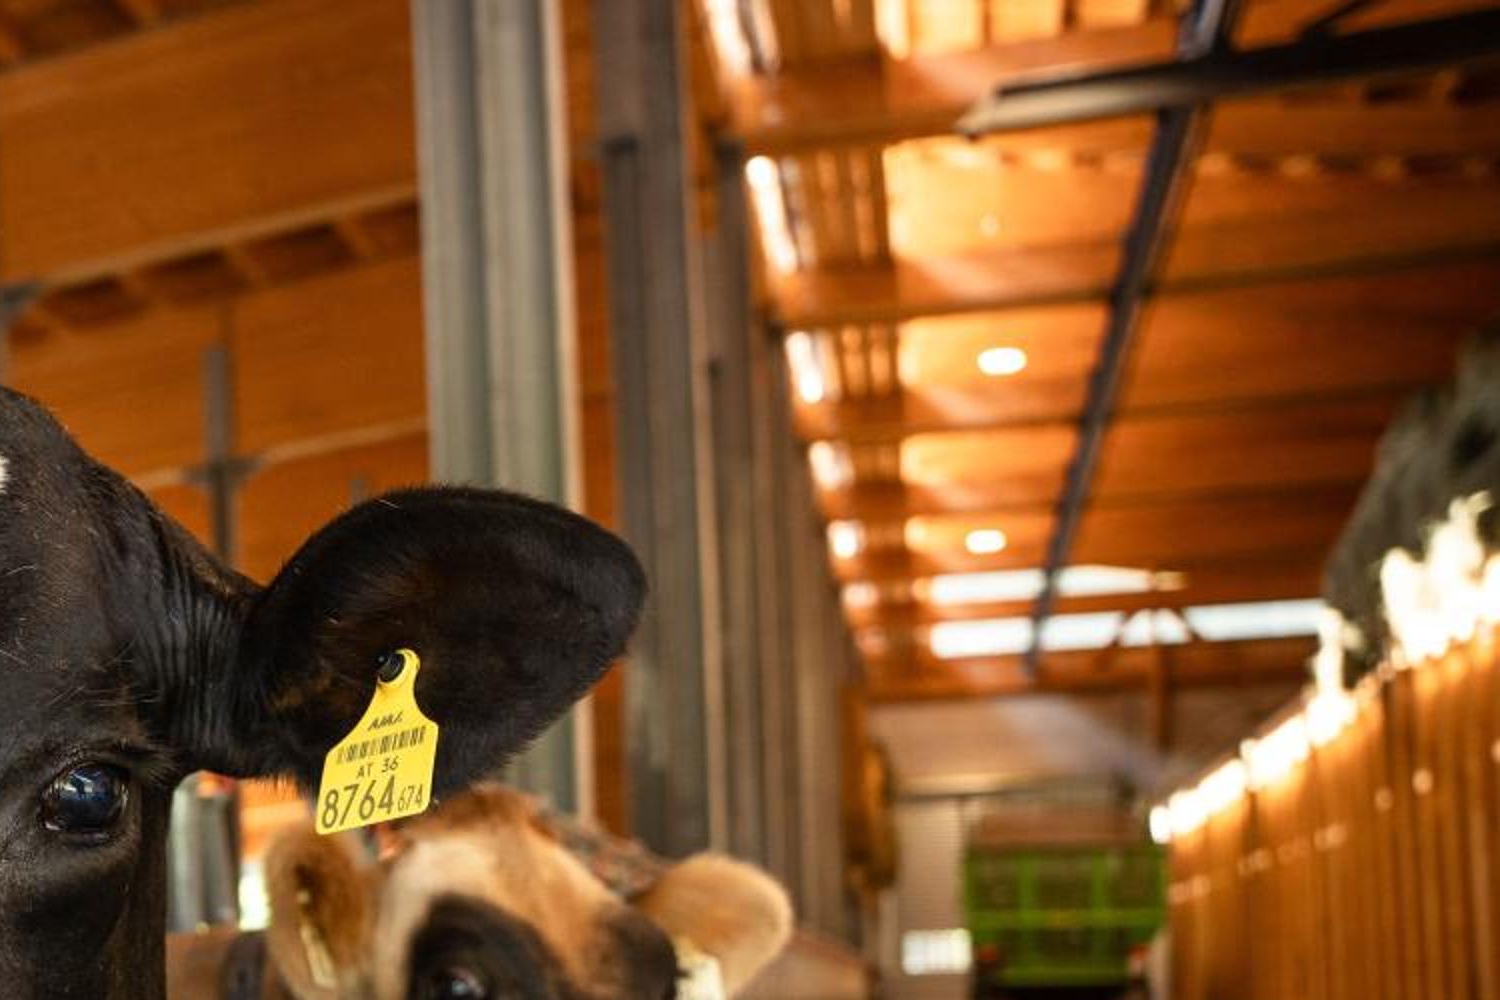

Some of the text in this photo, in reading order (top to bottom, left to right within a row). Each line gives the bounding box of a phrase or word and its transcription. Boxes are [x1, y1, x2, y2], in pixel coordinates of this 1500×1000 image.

[357, 762, 374, 779] AT
[322, 774, 423, 829] 8764 674
